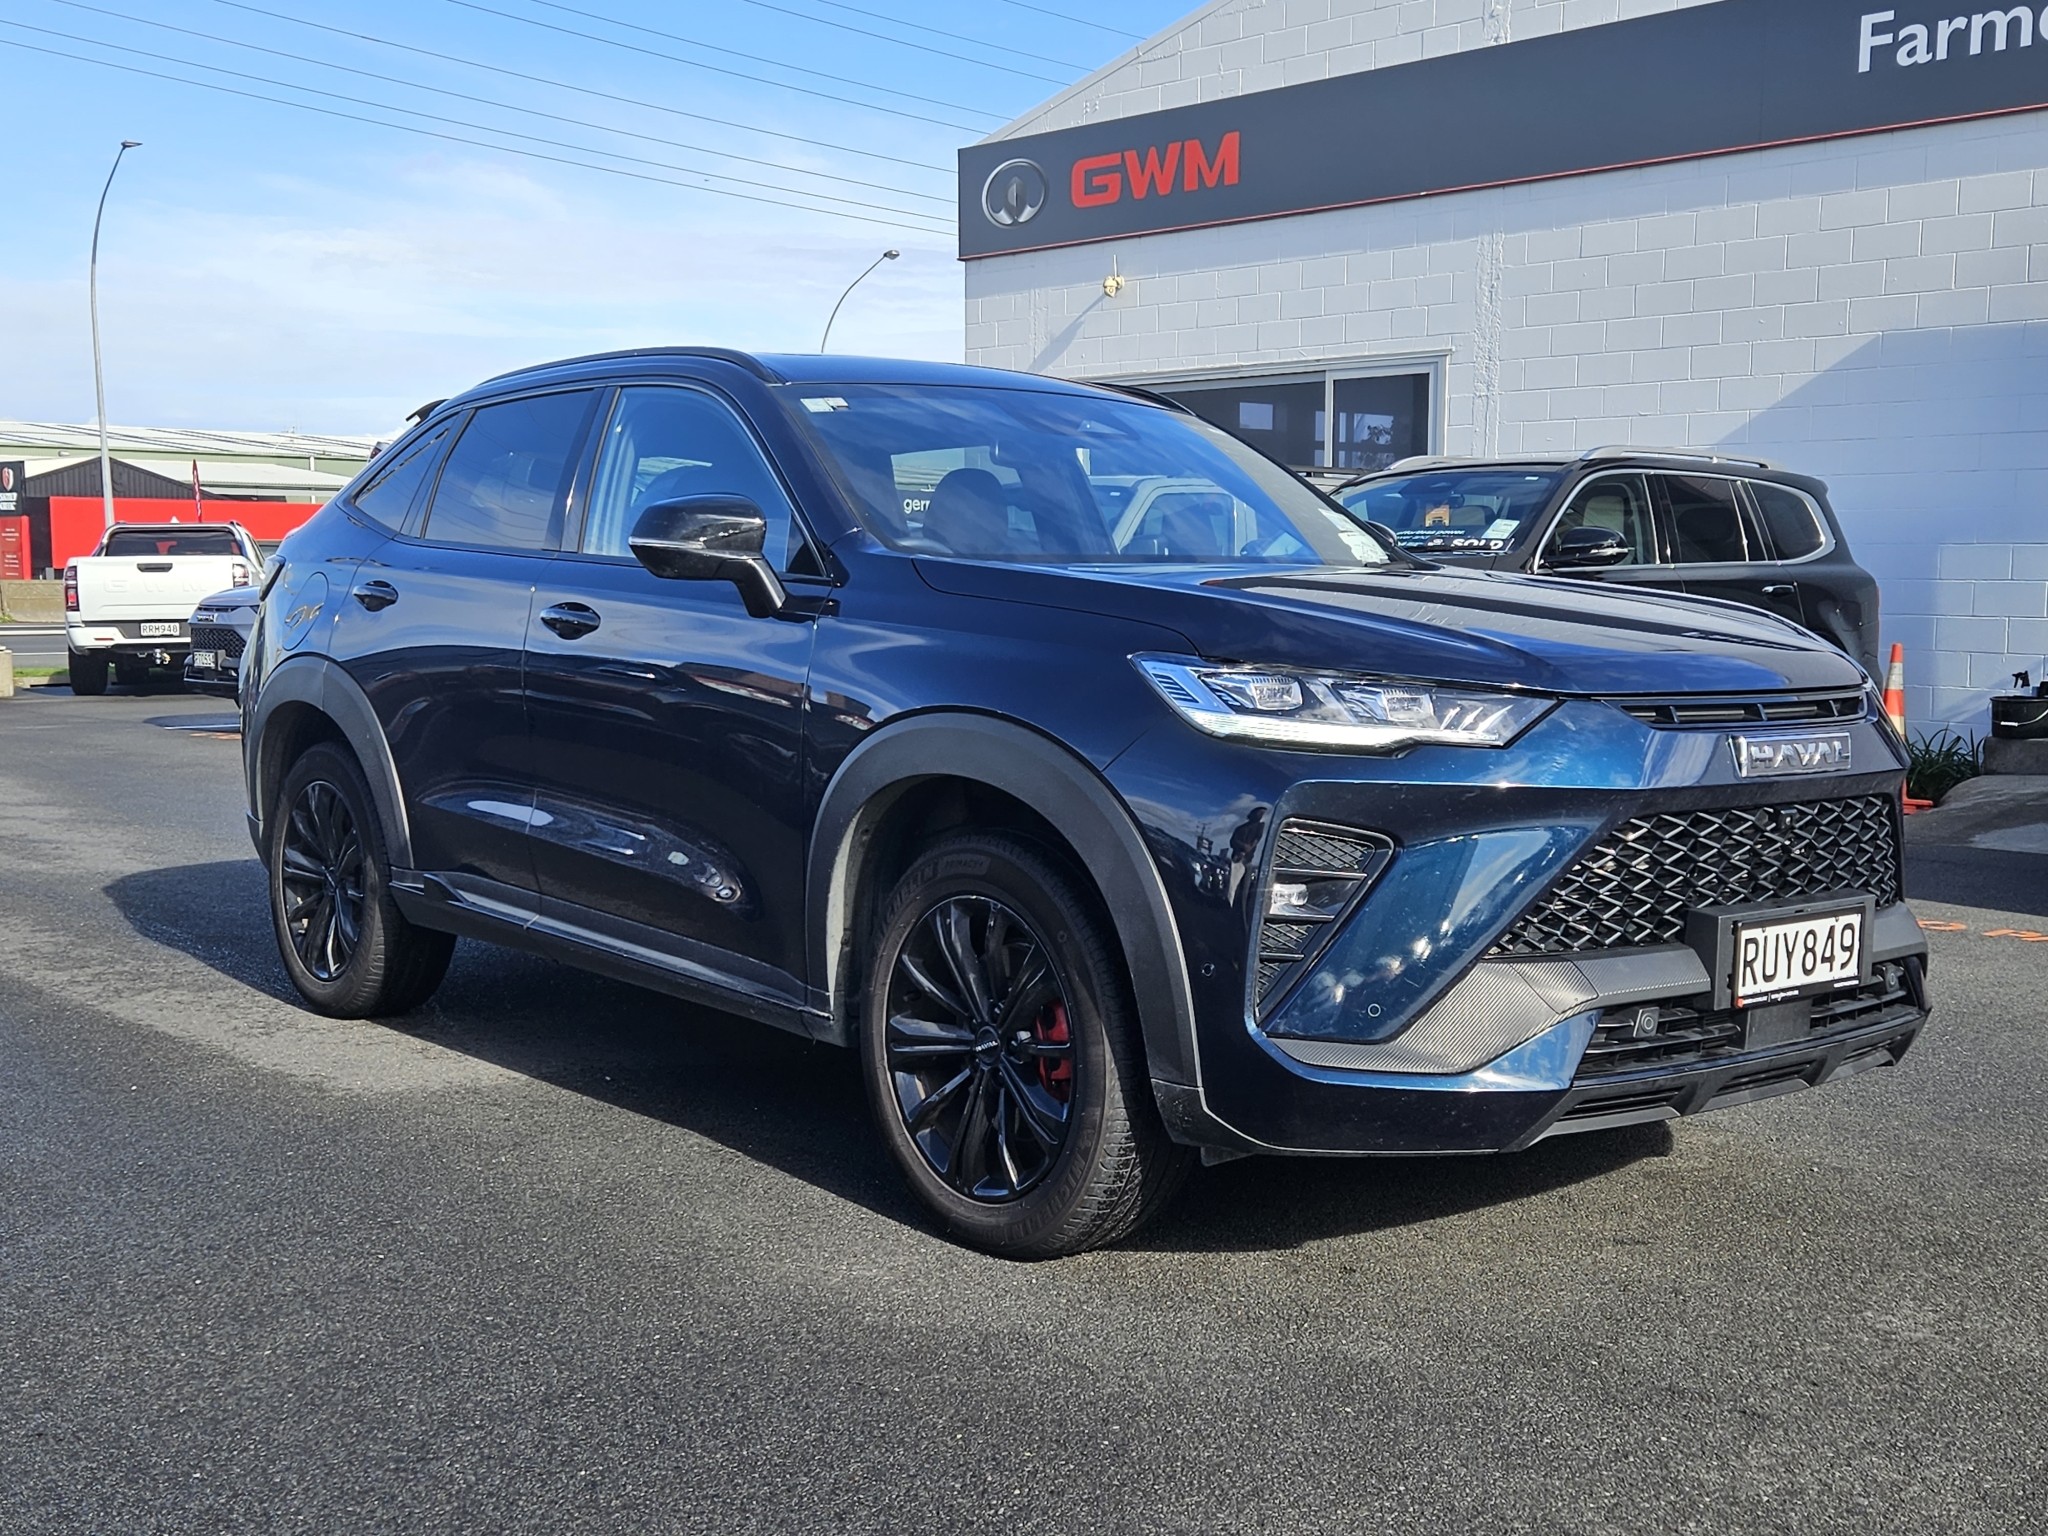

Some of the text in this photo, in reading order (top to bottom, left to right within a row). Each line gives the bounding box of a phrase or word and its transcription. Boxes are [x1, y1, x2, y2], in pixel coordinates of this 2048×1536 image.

[1071, 131, 1240, 208] GWM
[142, 624, 178, 634] RRH948
[1750, 741, 1850, 769] HAVAL
[1742, 922, 1856, 988] RUY849
